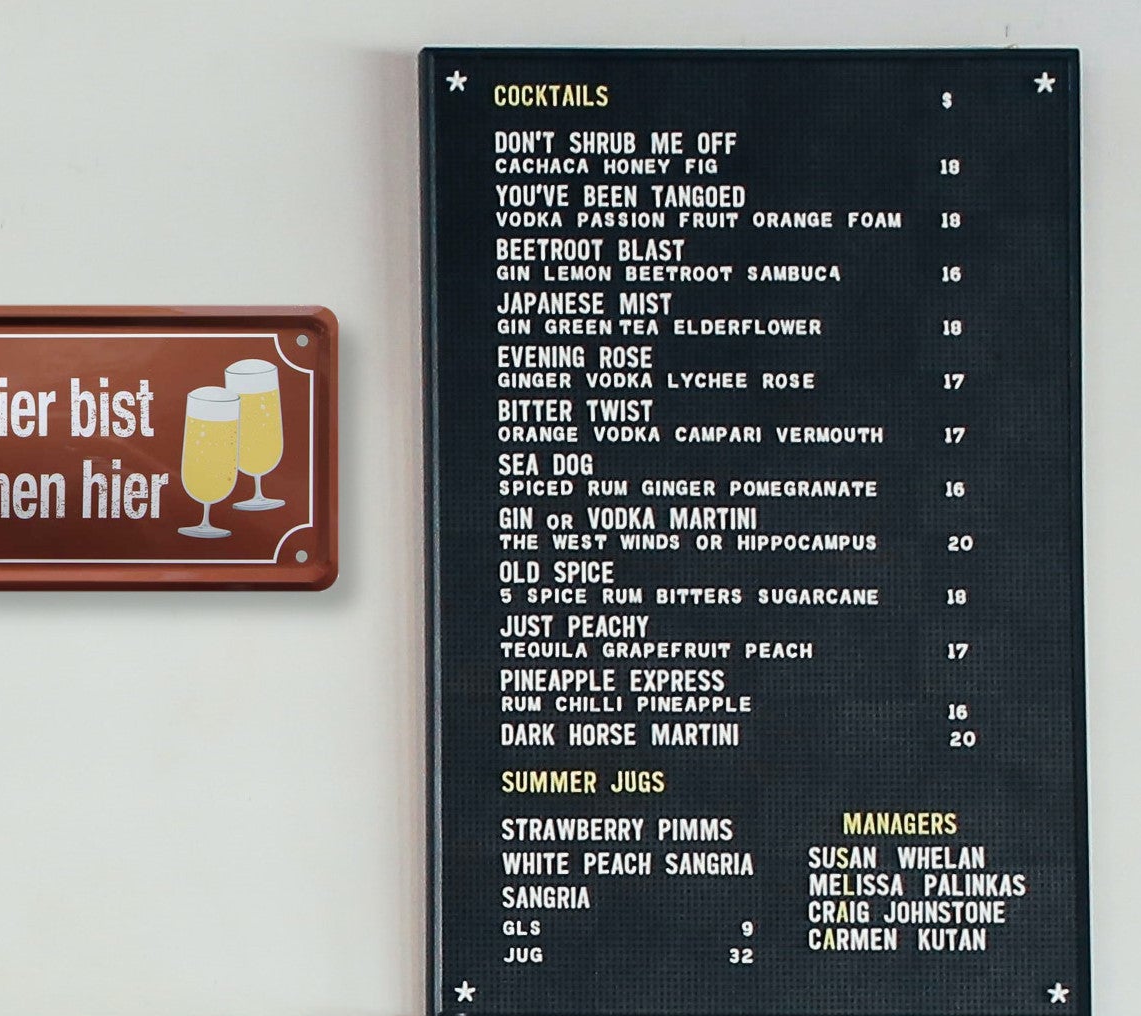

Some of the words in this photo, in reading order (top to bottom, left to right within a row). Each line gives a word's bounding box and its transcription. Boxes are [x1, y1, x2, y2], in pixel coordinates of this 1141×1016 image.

[494, 84, 609, 107] COCKTAILS
[494, 130, 555, 154] DON'T
[569, 131, 636, 155] SHRUB
[650, 131, 684, 155] ME
[697, 131, 737, 155] OFF
[495, 157, 589, 175] CACHACA
[603, 158, 671, 175] HONEY
[685, 158, 718, 175] FIG
[940, 158, 960, 176] 18
[495, 183, 569, 208] YOU'VE
[583, 184, 638, 208] BEEN
[650, 184, 746, 209] TANGOED
[495, 211, 563, 228] VODKA
[577, 211, 665, 229] PASSION
[679, 211, 739, 229] FRUIT
[752, 211, 833, 229] ORANGE
[847, 211, 902, 229] FOAM
[941, 212, 961, 229] 18
[496, 238, 604, 262] BEETROOT
[618, 238, 685, 262] BLAST
[496, 264, 530, 282] GIN
[544, 265, 612, 282] LEMON
[625, 265, 733, 282] BEETROOT
[941, 265, 962, 283] 16
[496, 291, 605, 315] JAPANESE
[619, 292, 673, 316] MIST
[497, 318, 531, 335] GIN
[544, 318, 616, 336] GREEN
[618, 318, 659, 336] TEA
[673, 318, 822, 336] ELDERFLOWER
[942, 319, 962, 336] 18
[497, 345, 585, 369] EVENING
[599, 345, 653, 370] ROSE
[497, 372, 572, 389] GINGER
[585, 372, 653, 389] VODKA
[667, 372, 748, 389] LYCHEE
[762, 372, 815, 390] ROSE
[943, 373, 965, 390] 17
[70, 376, 155, 438] bist
[498, 399, 573, 423] BITTER
[585, 399, 654, 423] TWIST
[497, 425, 579, 443] ORANGE
[593, 425, 661, 443] VODKA
[674, 426, 762, 443] CAMPARI
[775, 426, 884, 444] VERMOUTH
[944, 427, 966, 444] 17
[498, 452, 539, 477] SEA
[552, 453, 594, 476] DOG
[81, 458, 169, 520] hier
[499, 479, 574, 497] SPICED
[587, 479, 628, 497] RUM
[641, 479, 716, 497] GINGER
[729, 480, 878, 498] POMEGRANATE
[945, 480, 965, 498] 16
[499, 506, 533, 530] GIN
[546, 513, 574, 531] OR
[586, 506, 656, 530] VODKA
[669, 506, 757, 531] MARTINI
[499, 533, 539, 551] THE
[552, 533, 608, 551] WEST
[619, 533, 680, 551] WINDS
[695, 534, 723, 551] OR
[737, 534, 877, 552] HIPPOCAMPUS
[947, 535, 974, 552] 20
[499, 560, 540, 584] OLD
[553, 560, 615, 584] SPICE
[499, 587, 512, 604] 5
[527, 587, 587, 605] SPICE
[602, 587, 643, 605] RUM
[656, 587, 743, 605] BITTERS
[758, 588, 879, 606] SUGARCANE
[947, 588, 967, 606] 18
[499, 614, 554, 638] JUST
[567, 614, 649, 639] PEACHY
[500, 641, 588, 659] TEQUILA
[602, 641, 731, 659] GRAPEFRUIT
[745, 642, 813, 659] PEACH
[947, 642, 969, 660] 17
[500, 668, 616, 693] PINEAPPLE
[630, 669, 725, 693] EXPRESS
[501, 695, 542, 712] RUM
[555, 695, 623, 713] CHILLI
[637, 695, 752, 713] PINEAPPLE
[947, 703, 968, 721] 16
[501, 722, 556, 747] DARK
[569, 722, 637, 747] HORSE
[651, 722, 739, 747] MARTINI
[949, 730, 977, 748] 20
[501, 770, 597, 794] SUMMER
[610, 770, 665, 793] JUGS
[501, 817, 644, 842] STRAWBERRY
[658, 817, 734, 842] PIMMS
[843, 812, 958, 836] MANAGERS
[502, 851, 570, 876] WHITE
[583, 851, 652, 876] PEACH
[664, 852, 754, 876] SANGRIA
[808, 845, 877, 870] SUSAN
[897, 845, 985, 870] WHELAN
[809, 872, 904, 897] MELISSA
[924, 873, 1027, 898] PALINKAS
[502, 885, 591, 910] SANGRIA
[808, 900, 870, 924] CRAIG
[883, 900, 1006, 925] JOHNSTONE
[502, 920, 541, 936] GLS
[741, 920, 754, 937] 9
[808, 927, 898, 951] CARMEN
[917, 927, 987, 952] KUTAN
[503, 946, 543, 964] JUG
[729, 947, 754, 964] 32
